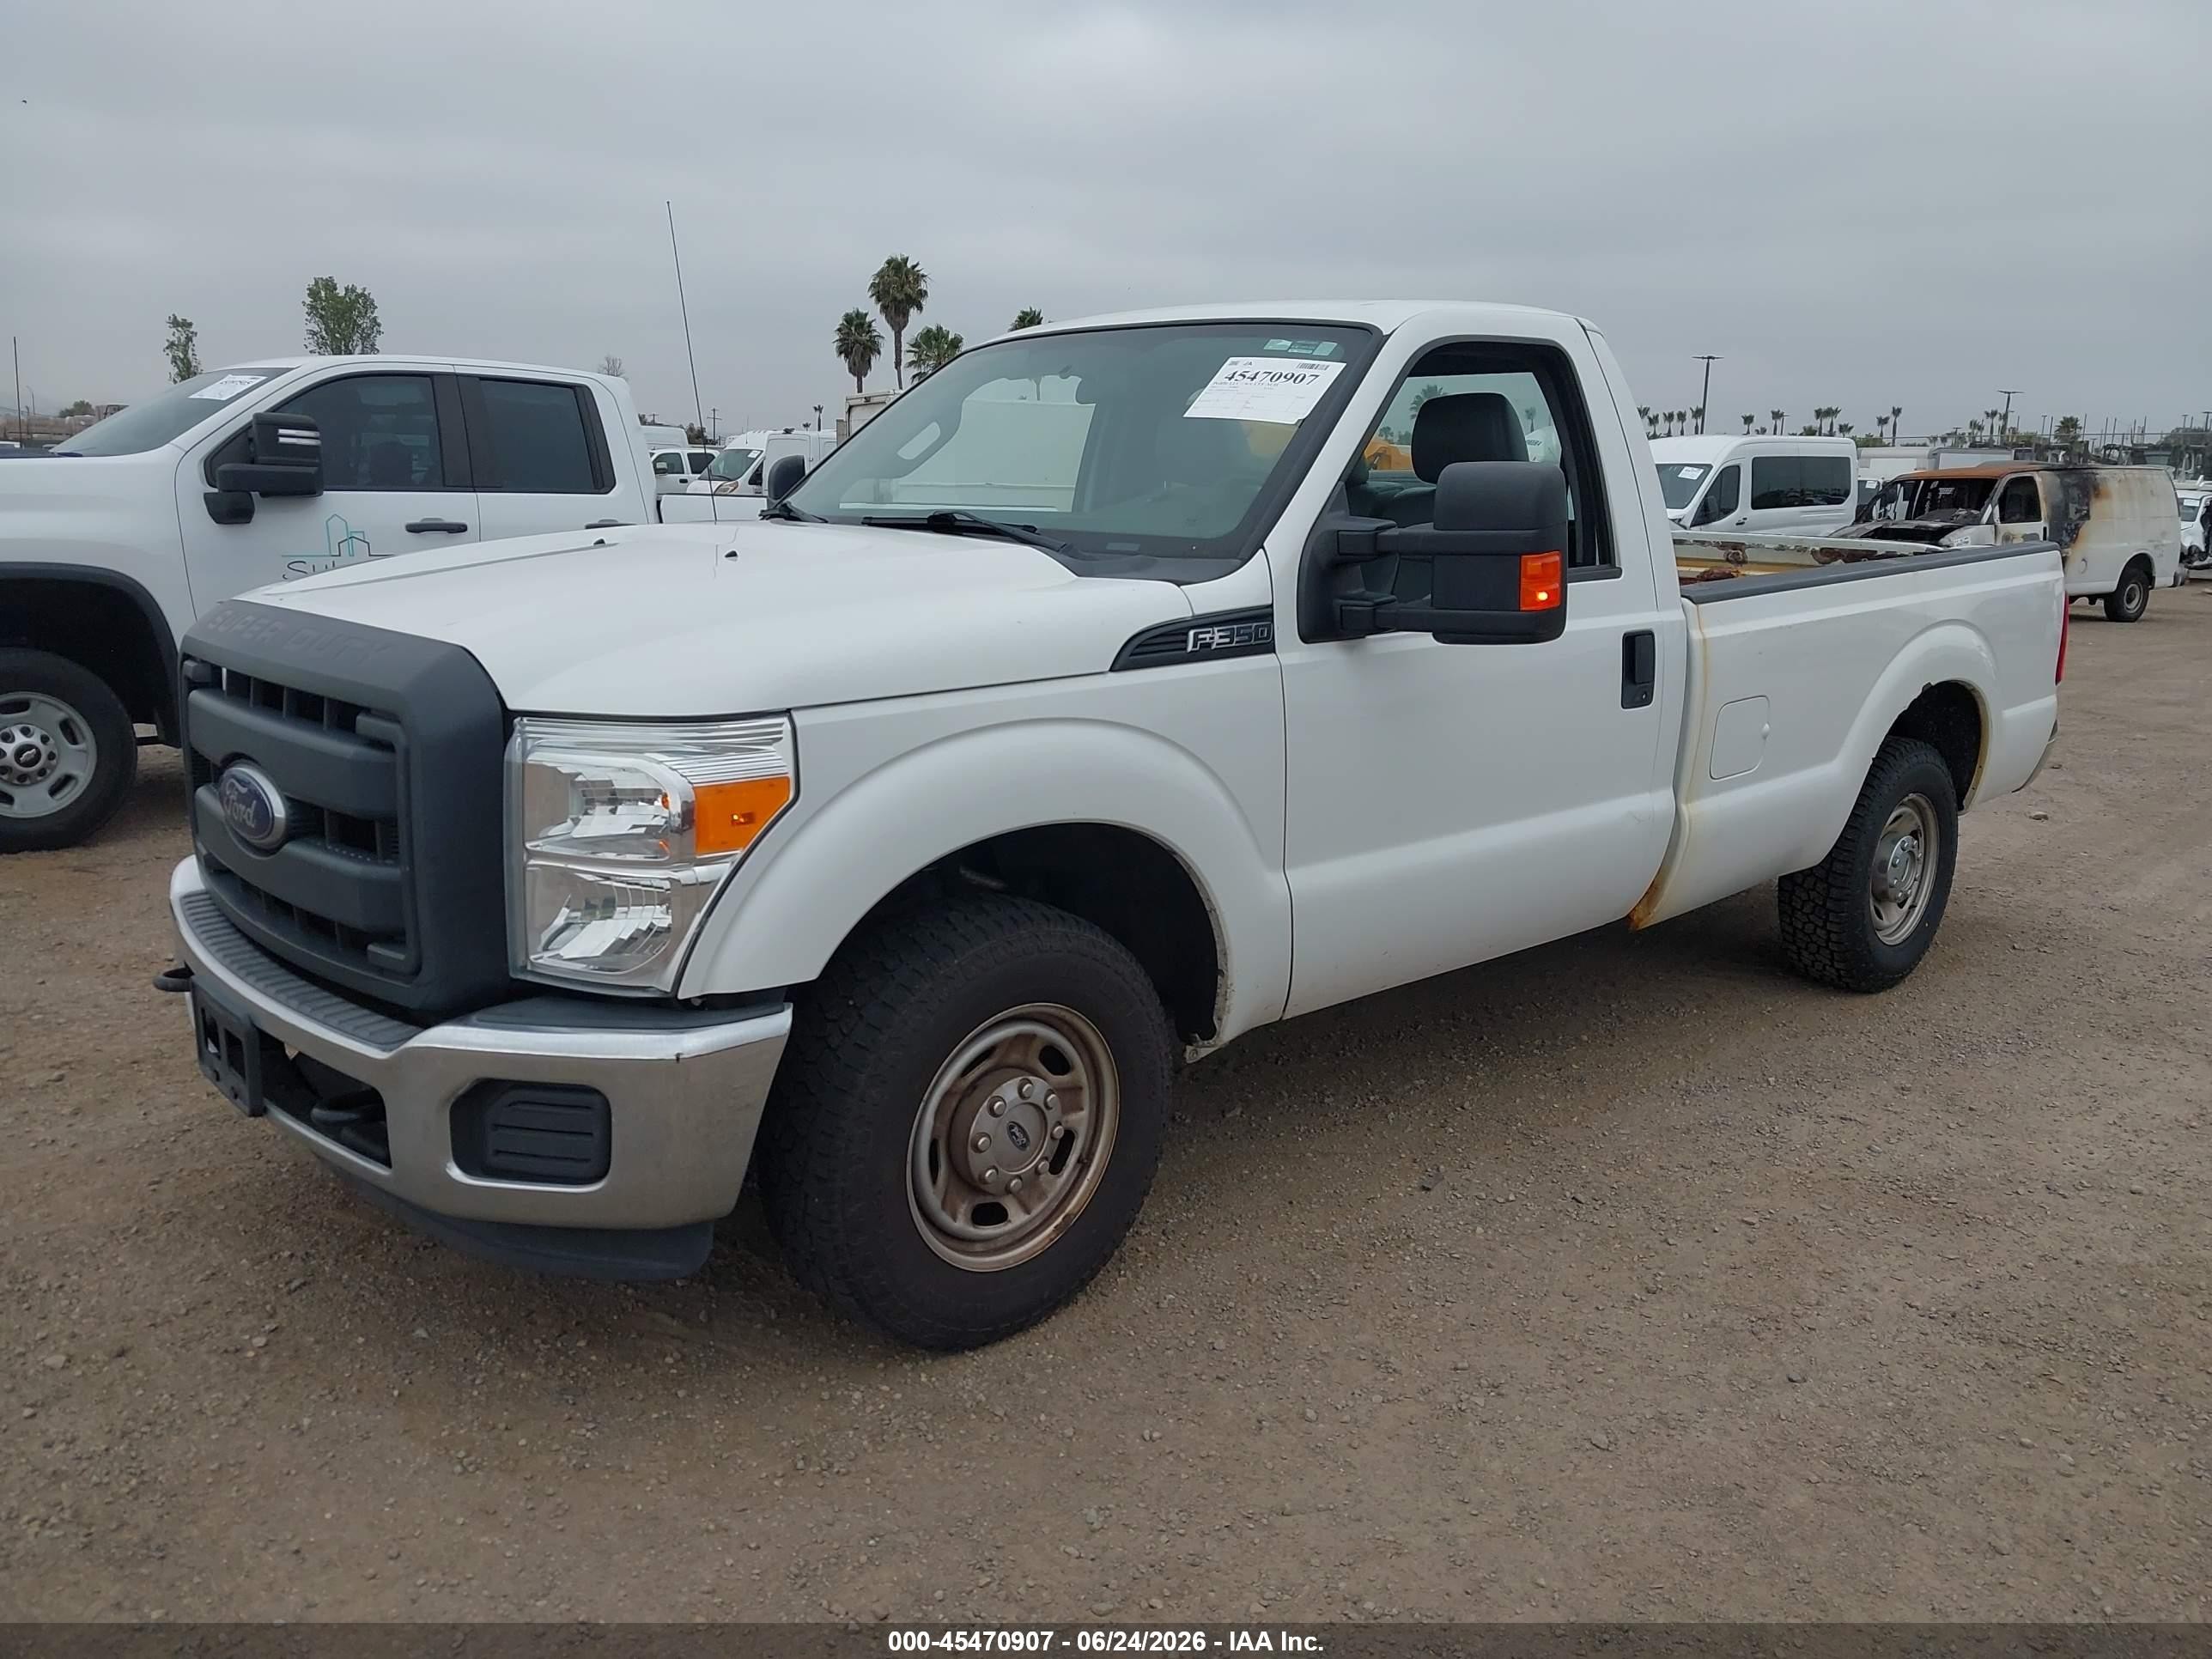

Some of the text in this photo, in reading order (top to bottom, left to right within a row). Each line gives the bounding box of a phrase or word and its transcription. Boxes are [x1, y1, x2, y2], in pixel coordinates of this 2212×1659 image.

[1224, 370, 1320, 386] 45470907
[207, 609, 395, 665] SUPER DUTY
[1187, 622, 1273, 653] F-350
[222, 777, 257, 829] Ford
